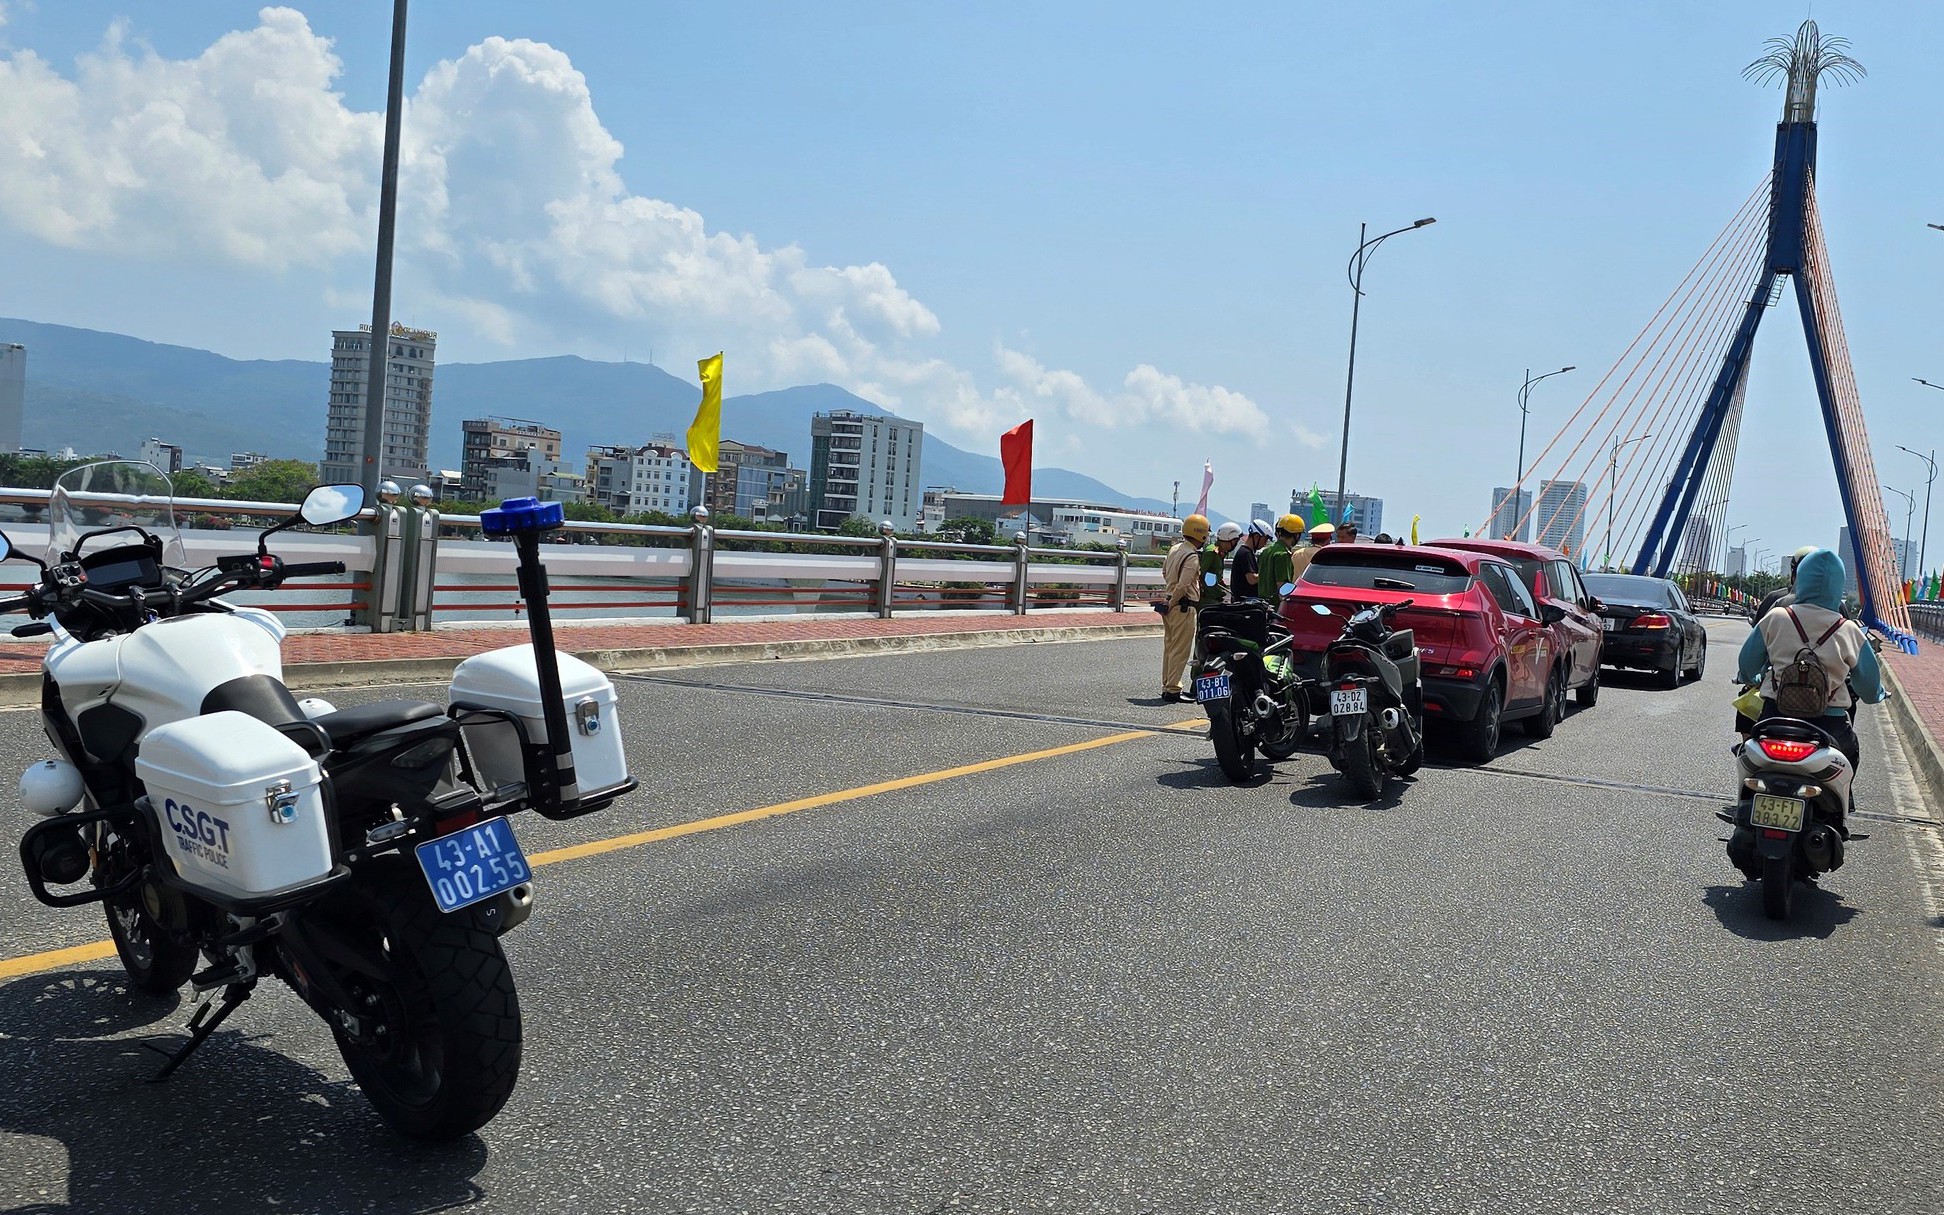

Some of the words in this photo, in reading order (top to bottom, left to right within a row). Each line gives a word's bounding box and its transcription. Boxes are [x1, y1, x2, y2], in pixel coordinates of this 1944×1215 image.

[1199, 686, 1228, 700] 011.06
[1201, 677, 1223, 689] 43-B1
[1334, 702, 1364, 713] 028.84
[1760, 798, 1795, 814] 43-F1
[165, 798, 229, 854] C.S.G.T
[177, 835, 204, 858] TRAFFIC
[204, 846, 229, 869] POLICE
[434, 825, 501, 871] 43-A1
[437, 851, 525, 905] 002.55
